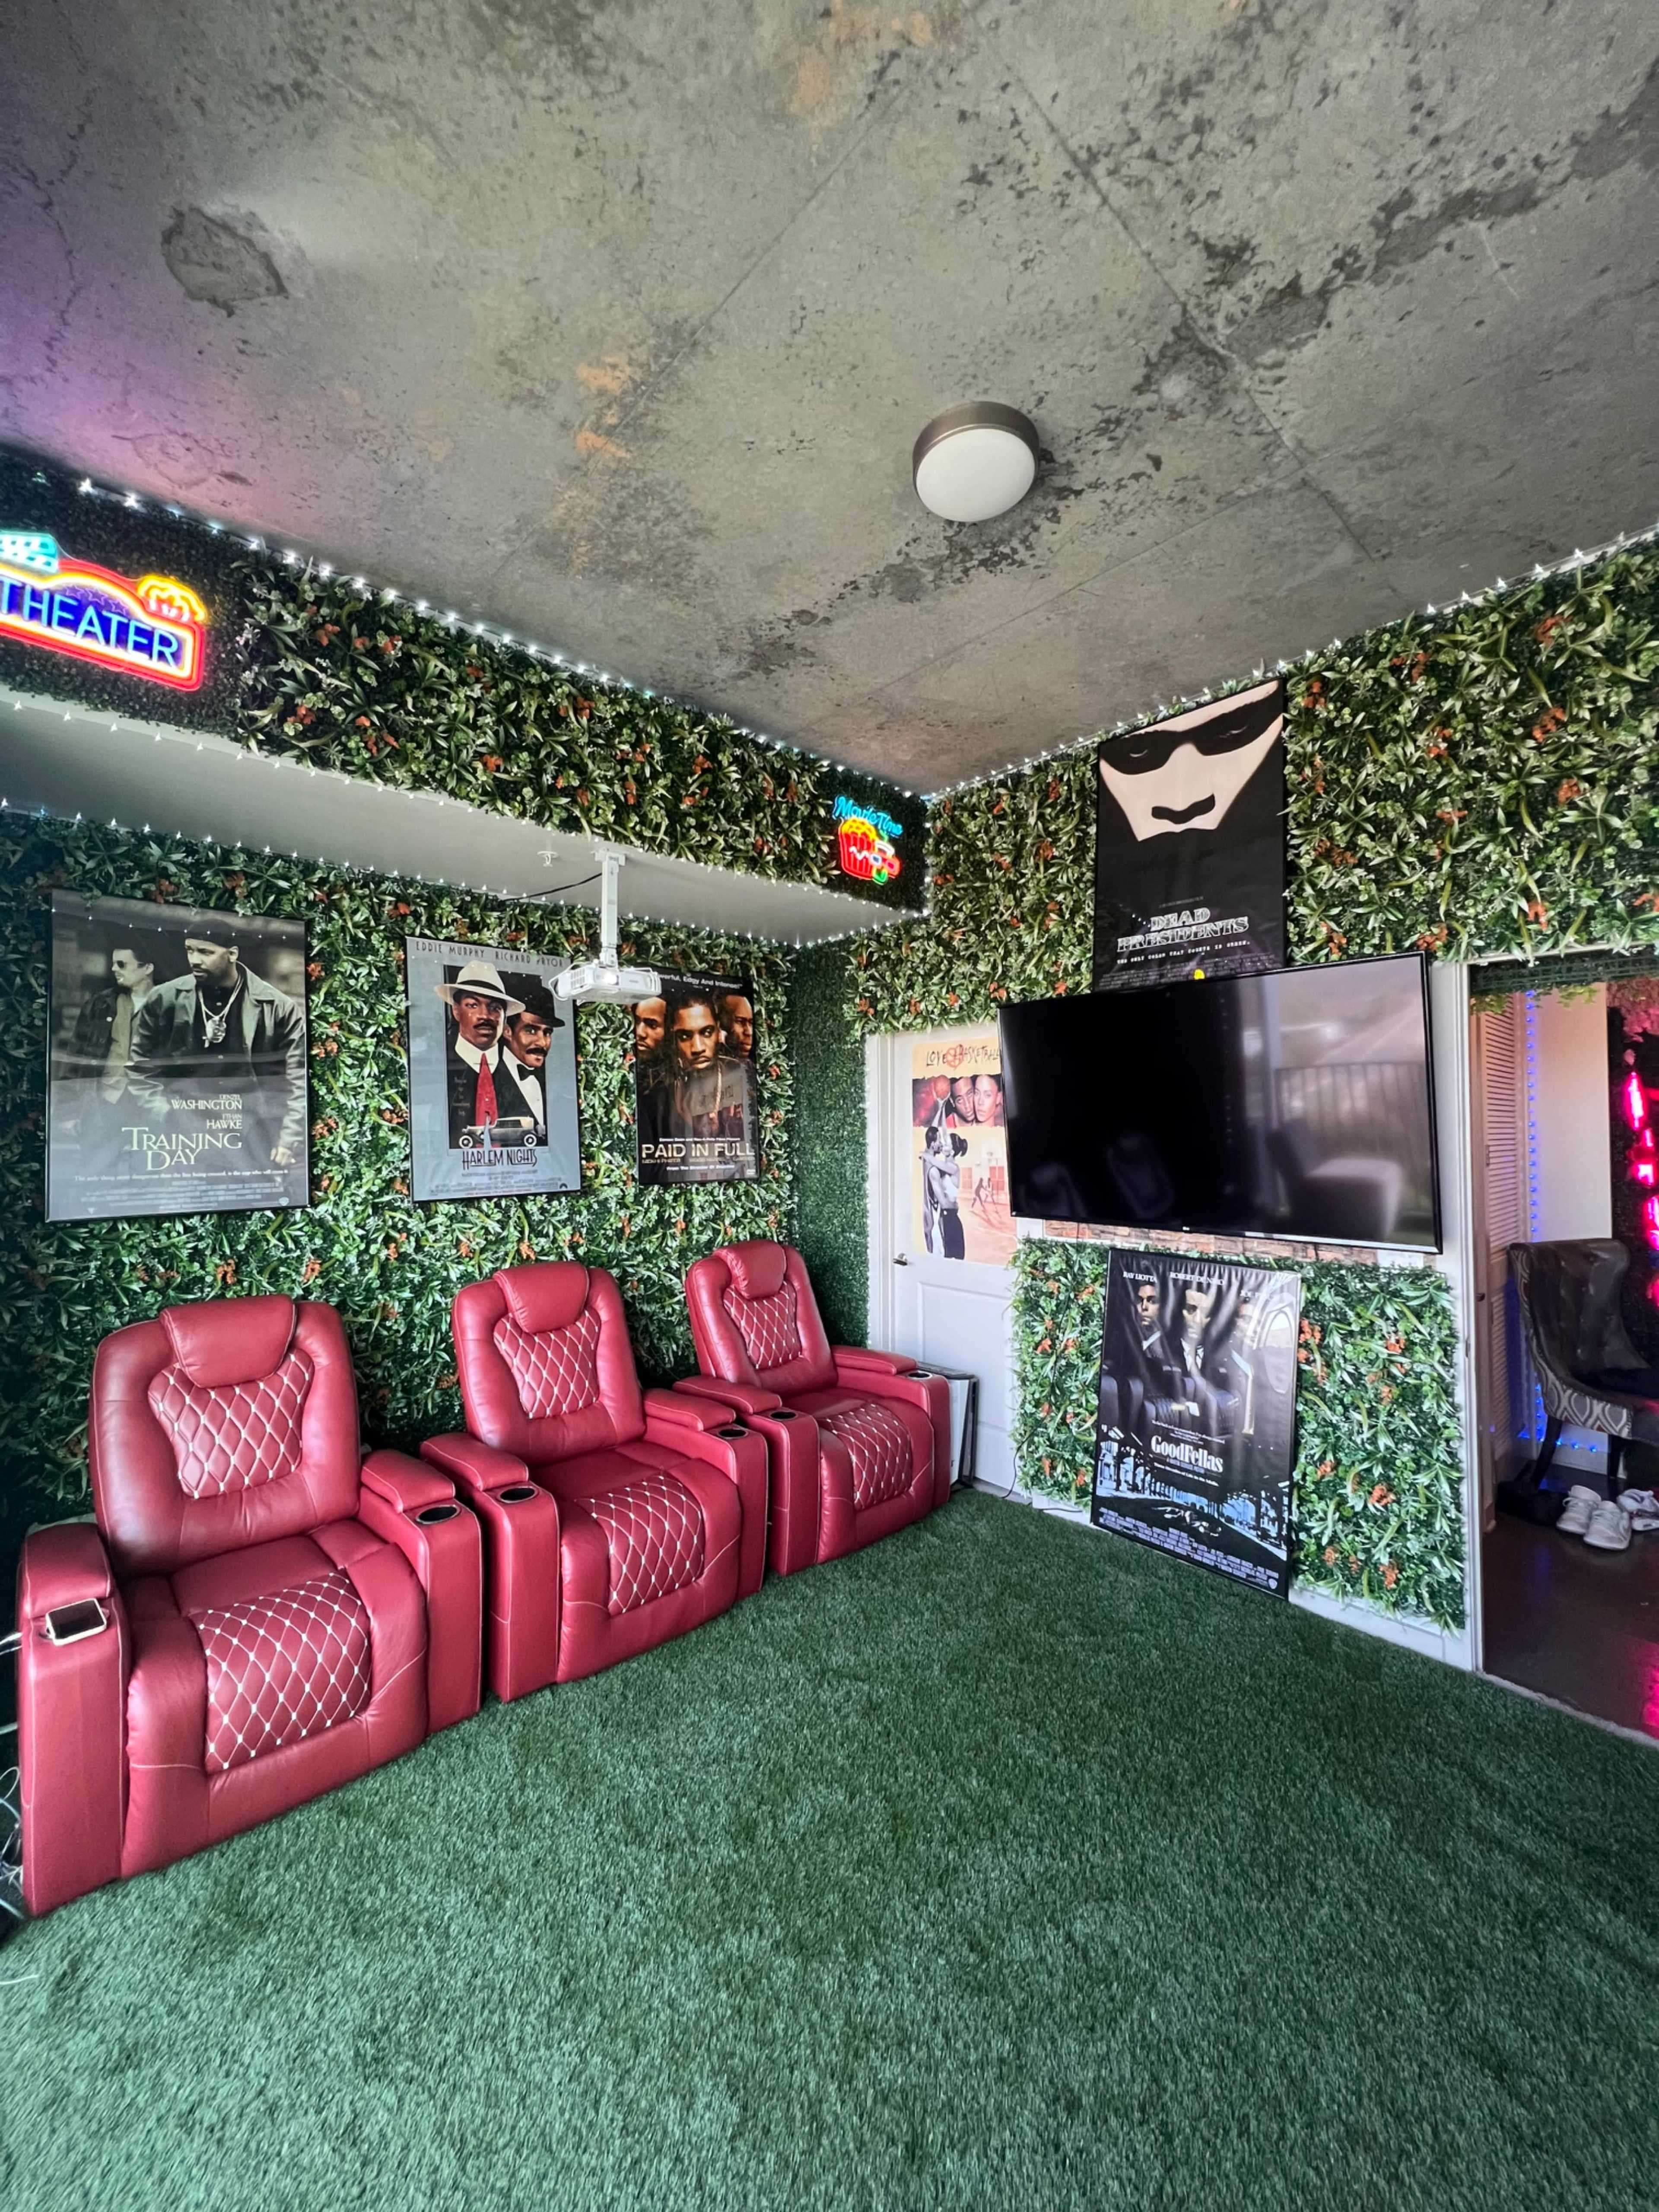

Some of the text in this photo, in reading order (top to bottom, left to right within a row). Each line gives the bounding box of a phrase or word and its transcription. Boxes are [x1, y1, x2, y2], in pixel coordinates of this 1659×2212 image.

[0, 575, 178, 667] THEATER
[1150, 907, 1211, 932] DEAD
[1117, 916, 1249, 952] PRESIDENTS
[416, 941, 442, 954] EDDIE
[449, 946, 485, 958] MURPHY
[495, 951, 531, 964] RICHARD
[171, 1099, 242, 1110] WASHINGTON
[207, 1119, 243, 1129] HAWKE
[121, 1127, 242, 1151] TRAINING
[642, 1143, 755, 1158] PAID IN FULL
[146, 1149, 202, 1171] DAY
[462, 1149, 537, 1170] HARLEM NIGHTS
[1150, 1435, 1223, 1473] GoodFellas
